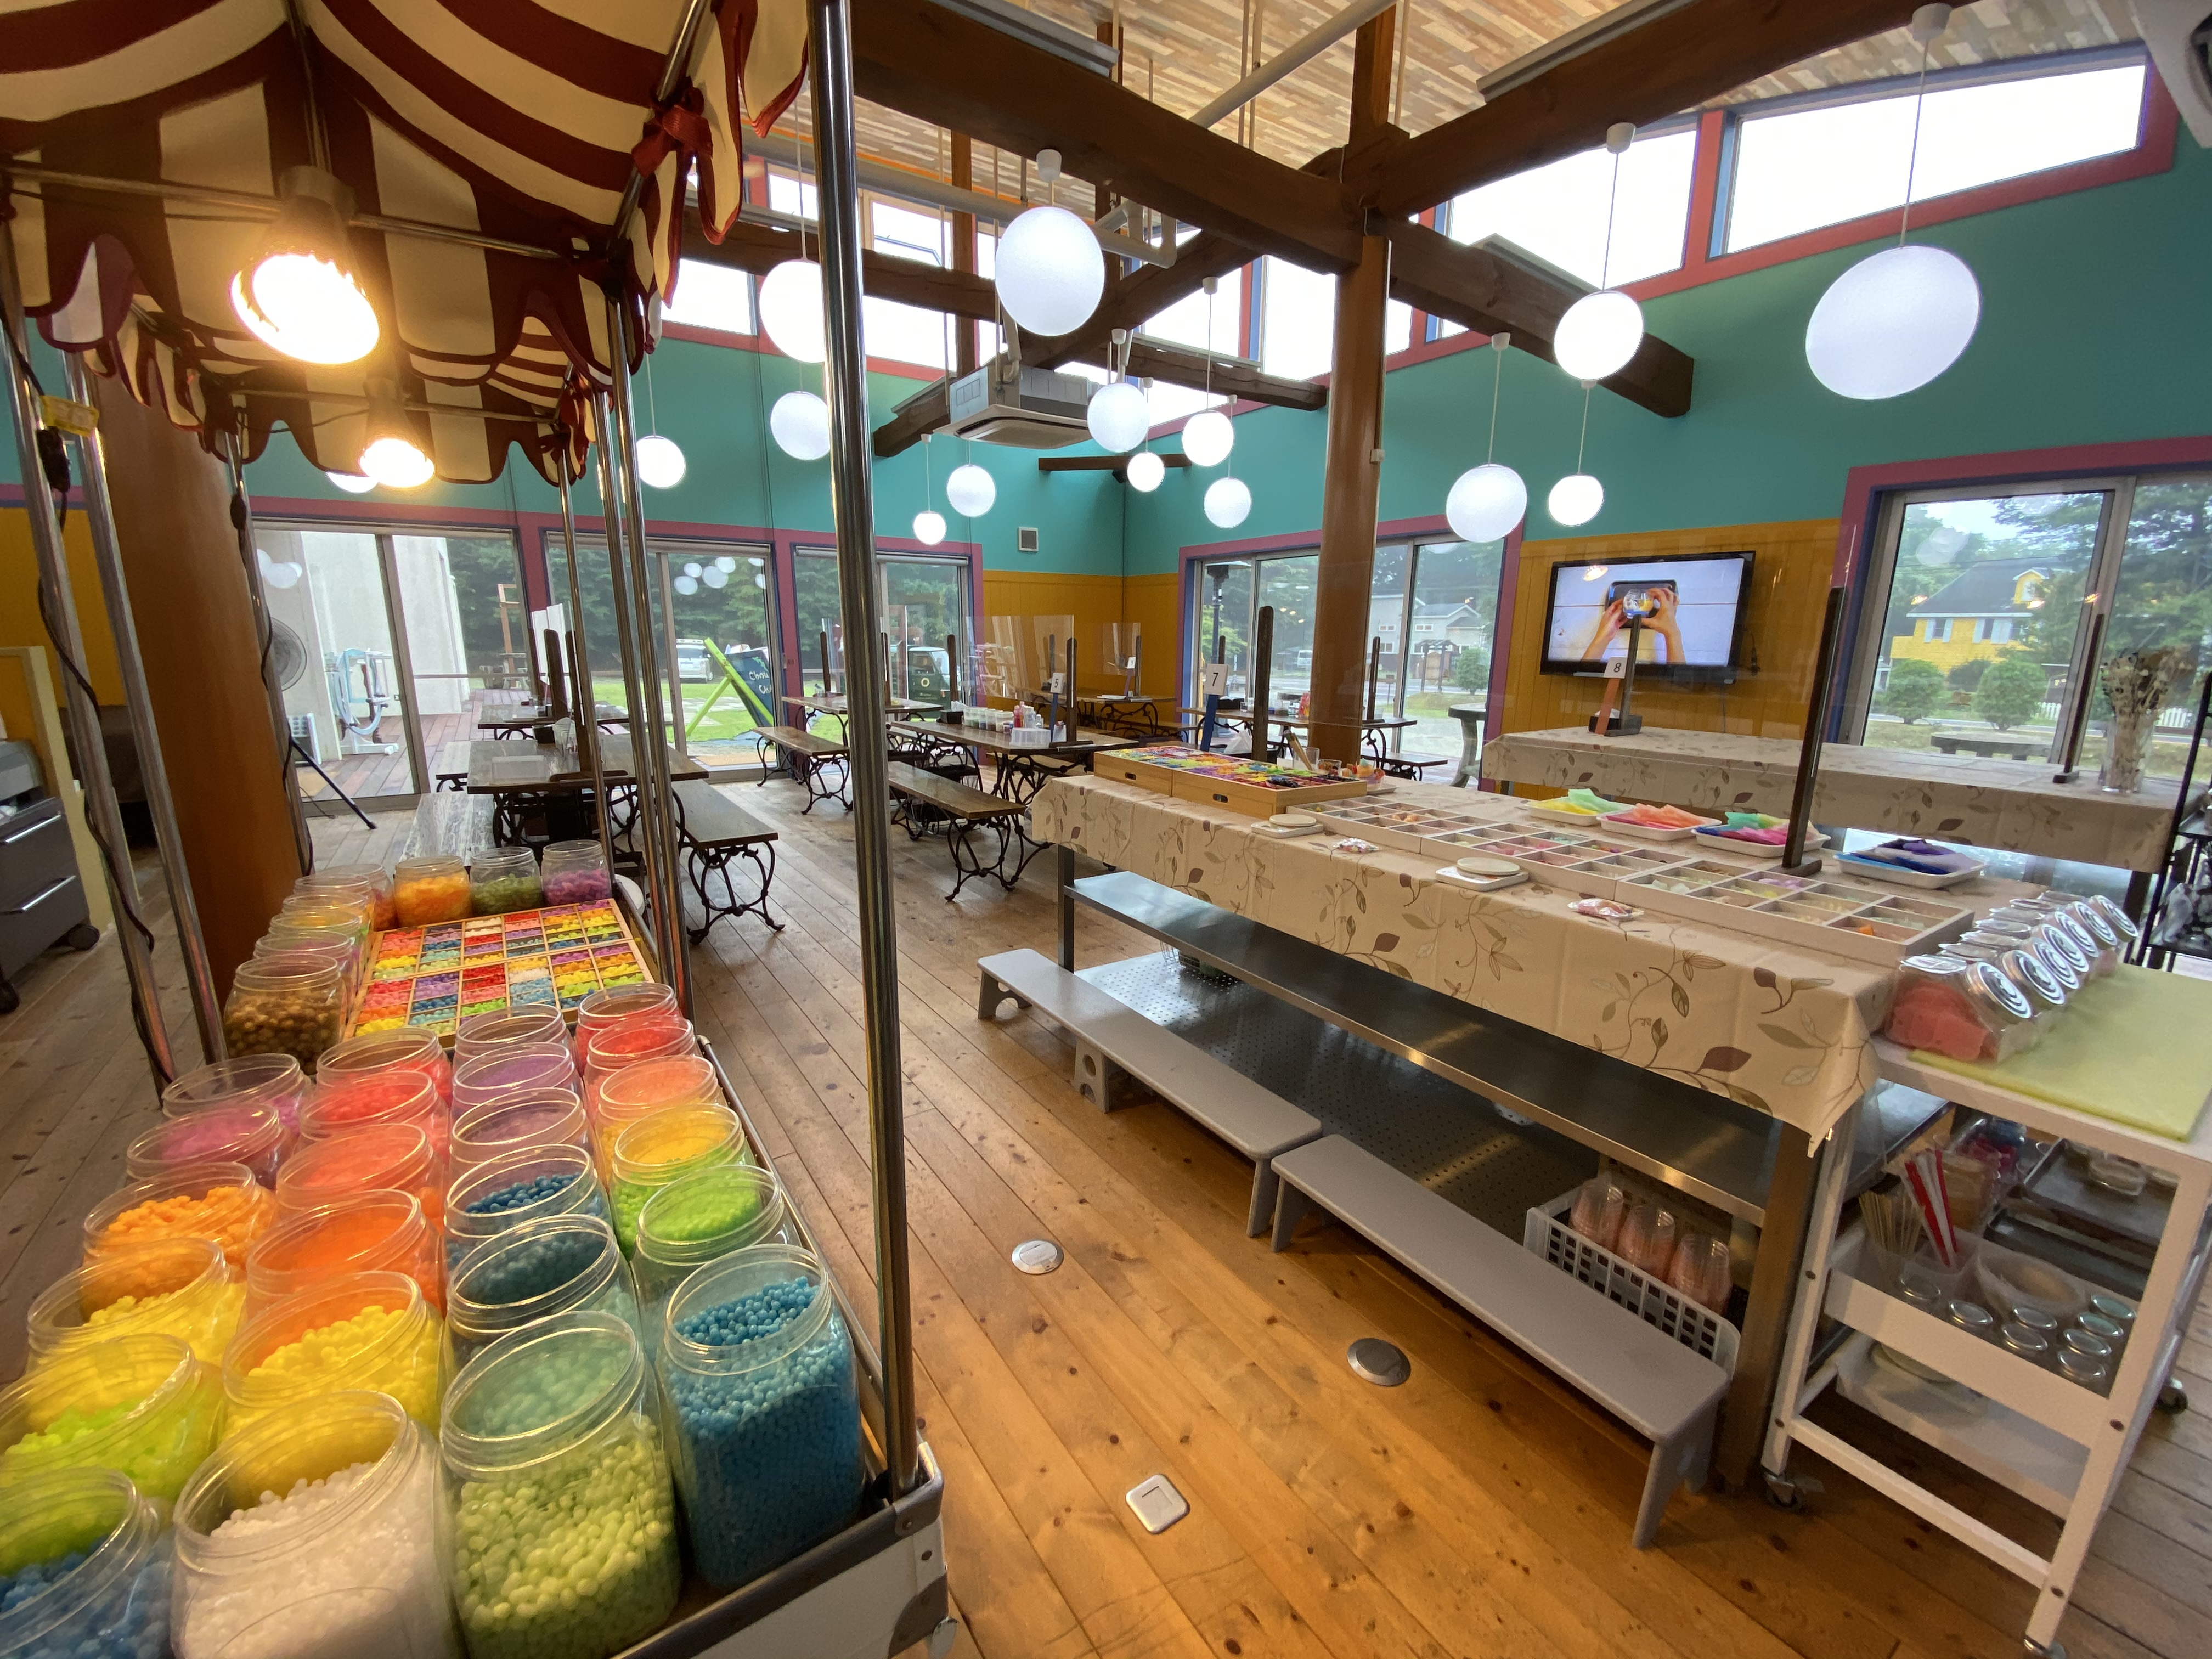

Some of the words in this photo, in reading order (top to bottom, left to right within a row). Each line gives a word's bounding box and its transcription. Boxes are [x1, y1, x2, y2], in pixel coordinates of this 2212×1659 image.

[1613, 662, 1622, 673] 8
[1054, 678, 1059, 689] 5
[1212, 673, 1218, 686] 7
